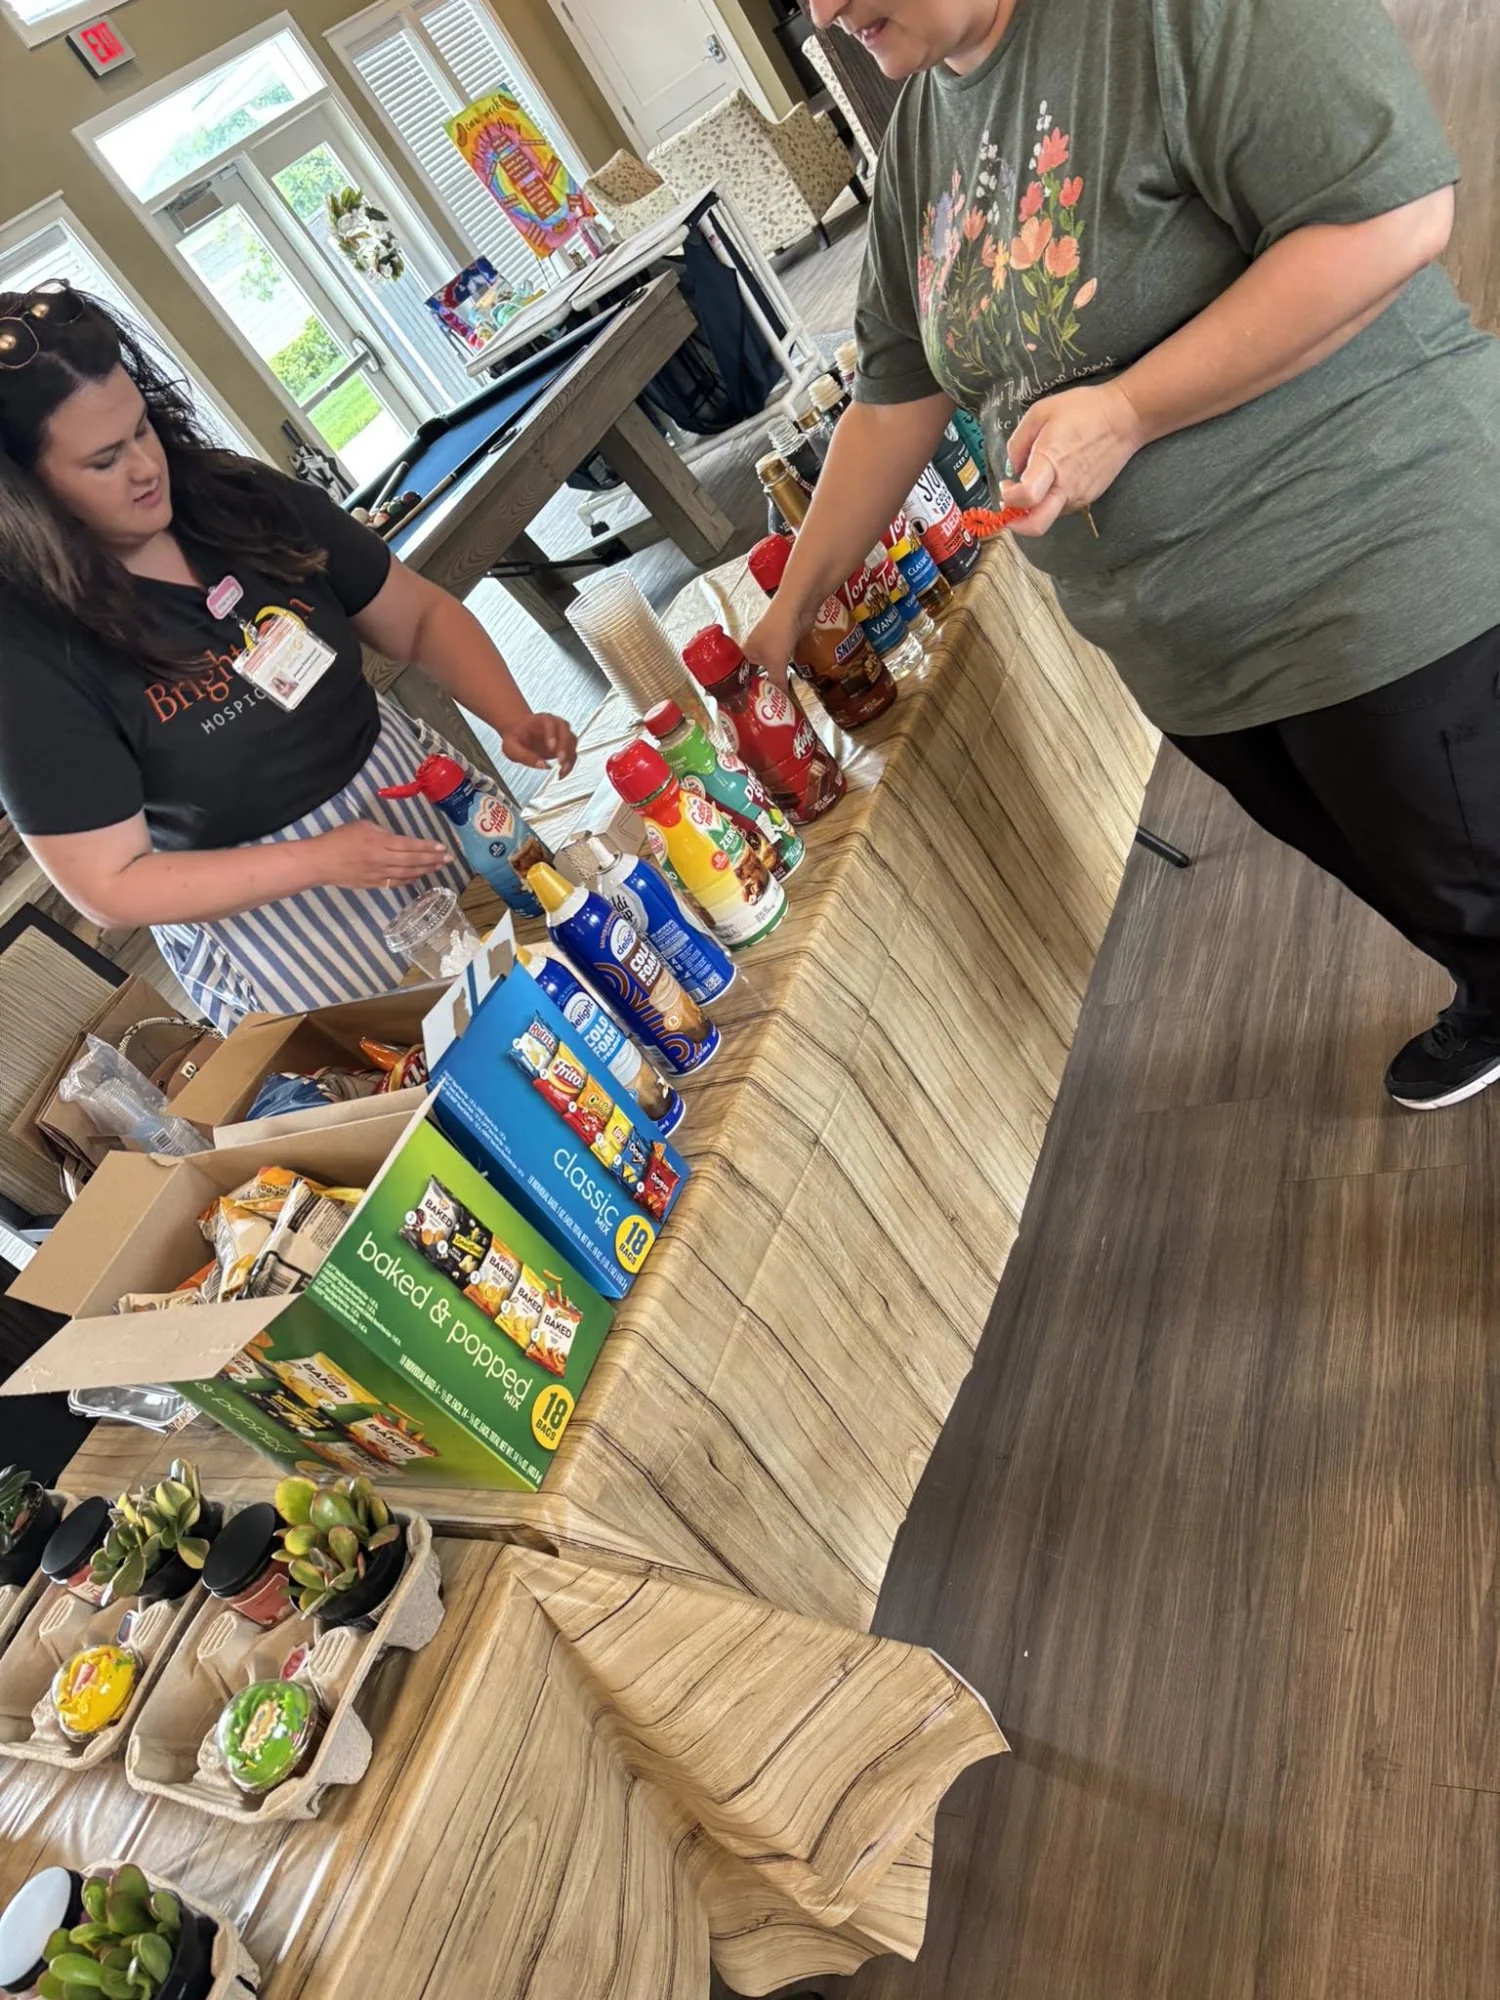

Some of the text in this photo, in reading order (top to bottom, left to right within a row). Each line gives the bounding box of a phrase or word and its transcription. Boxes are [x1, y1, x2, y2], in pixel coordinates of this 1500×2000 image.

[201, 687, 269, 735] HOSPIC
[572, 1000, 594, 1029] elight
[554, 1148, 619, 1227] classic
[425, 1198, 453, 1228] BAKED
[594, 1216, 611, 1236] MIX
[625, 1220, 649, 1256] 18
[618, 1243, 637, 1265] BAGS
[489, 1255, 514, 1284] BAKED
[518, 1287, 543, 1314] BAKED
[357, 1231, 434, 1310] baked
[429, 1298, 452, 1329] &
[446, 1319, 534, 1401] popped
[544, 1314, 572, 1339] BAKED
[302, 1362, 348, 1399] BAKED
[504, 1390, 522, 1412] MIX
[542, 1392, 569, 1430] 18
[211, 1397, 297, 1454] popped
[367, 1423, 417, 1455] BAKED
[535, 1418, 557, 1442] BAGS
